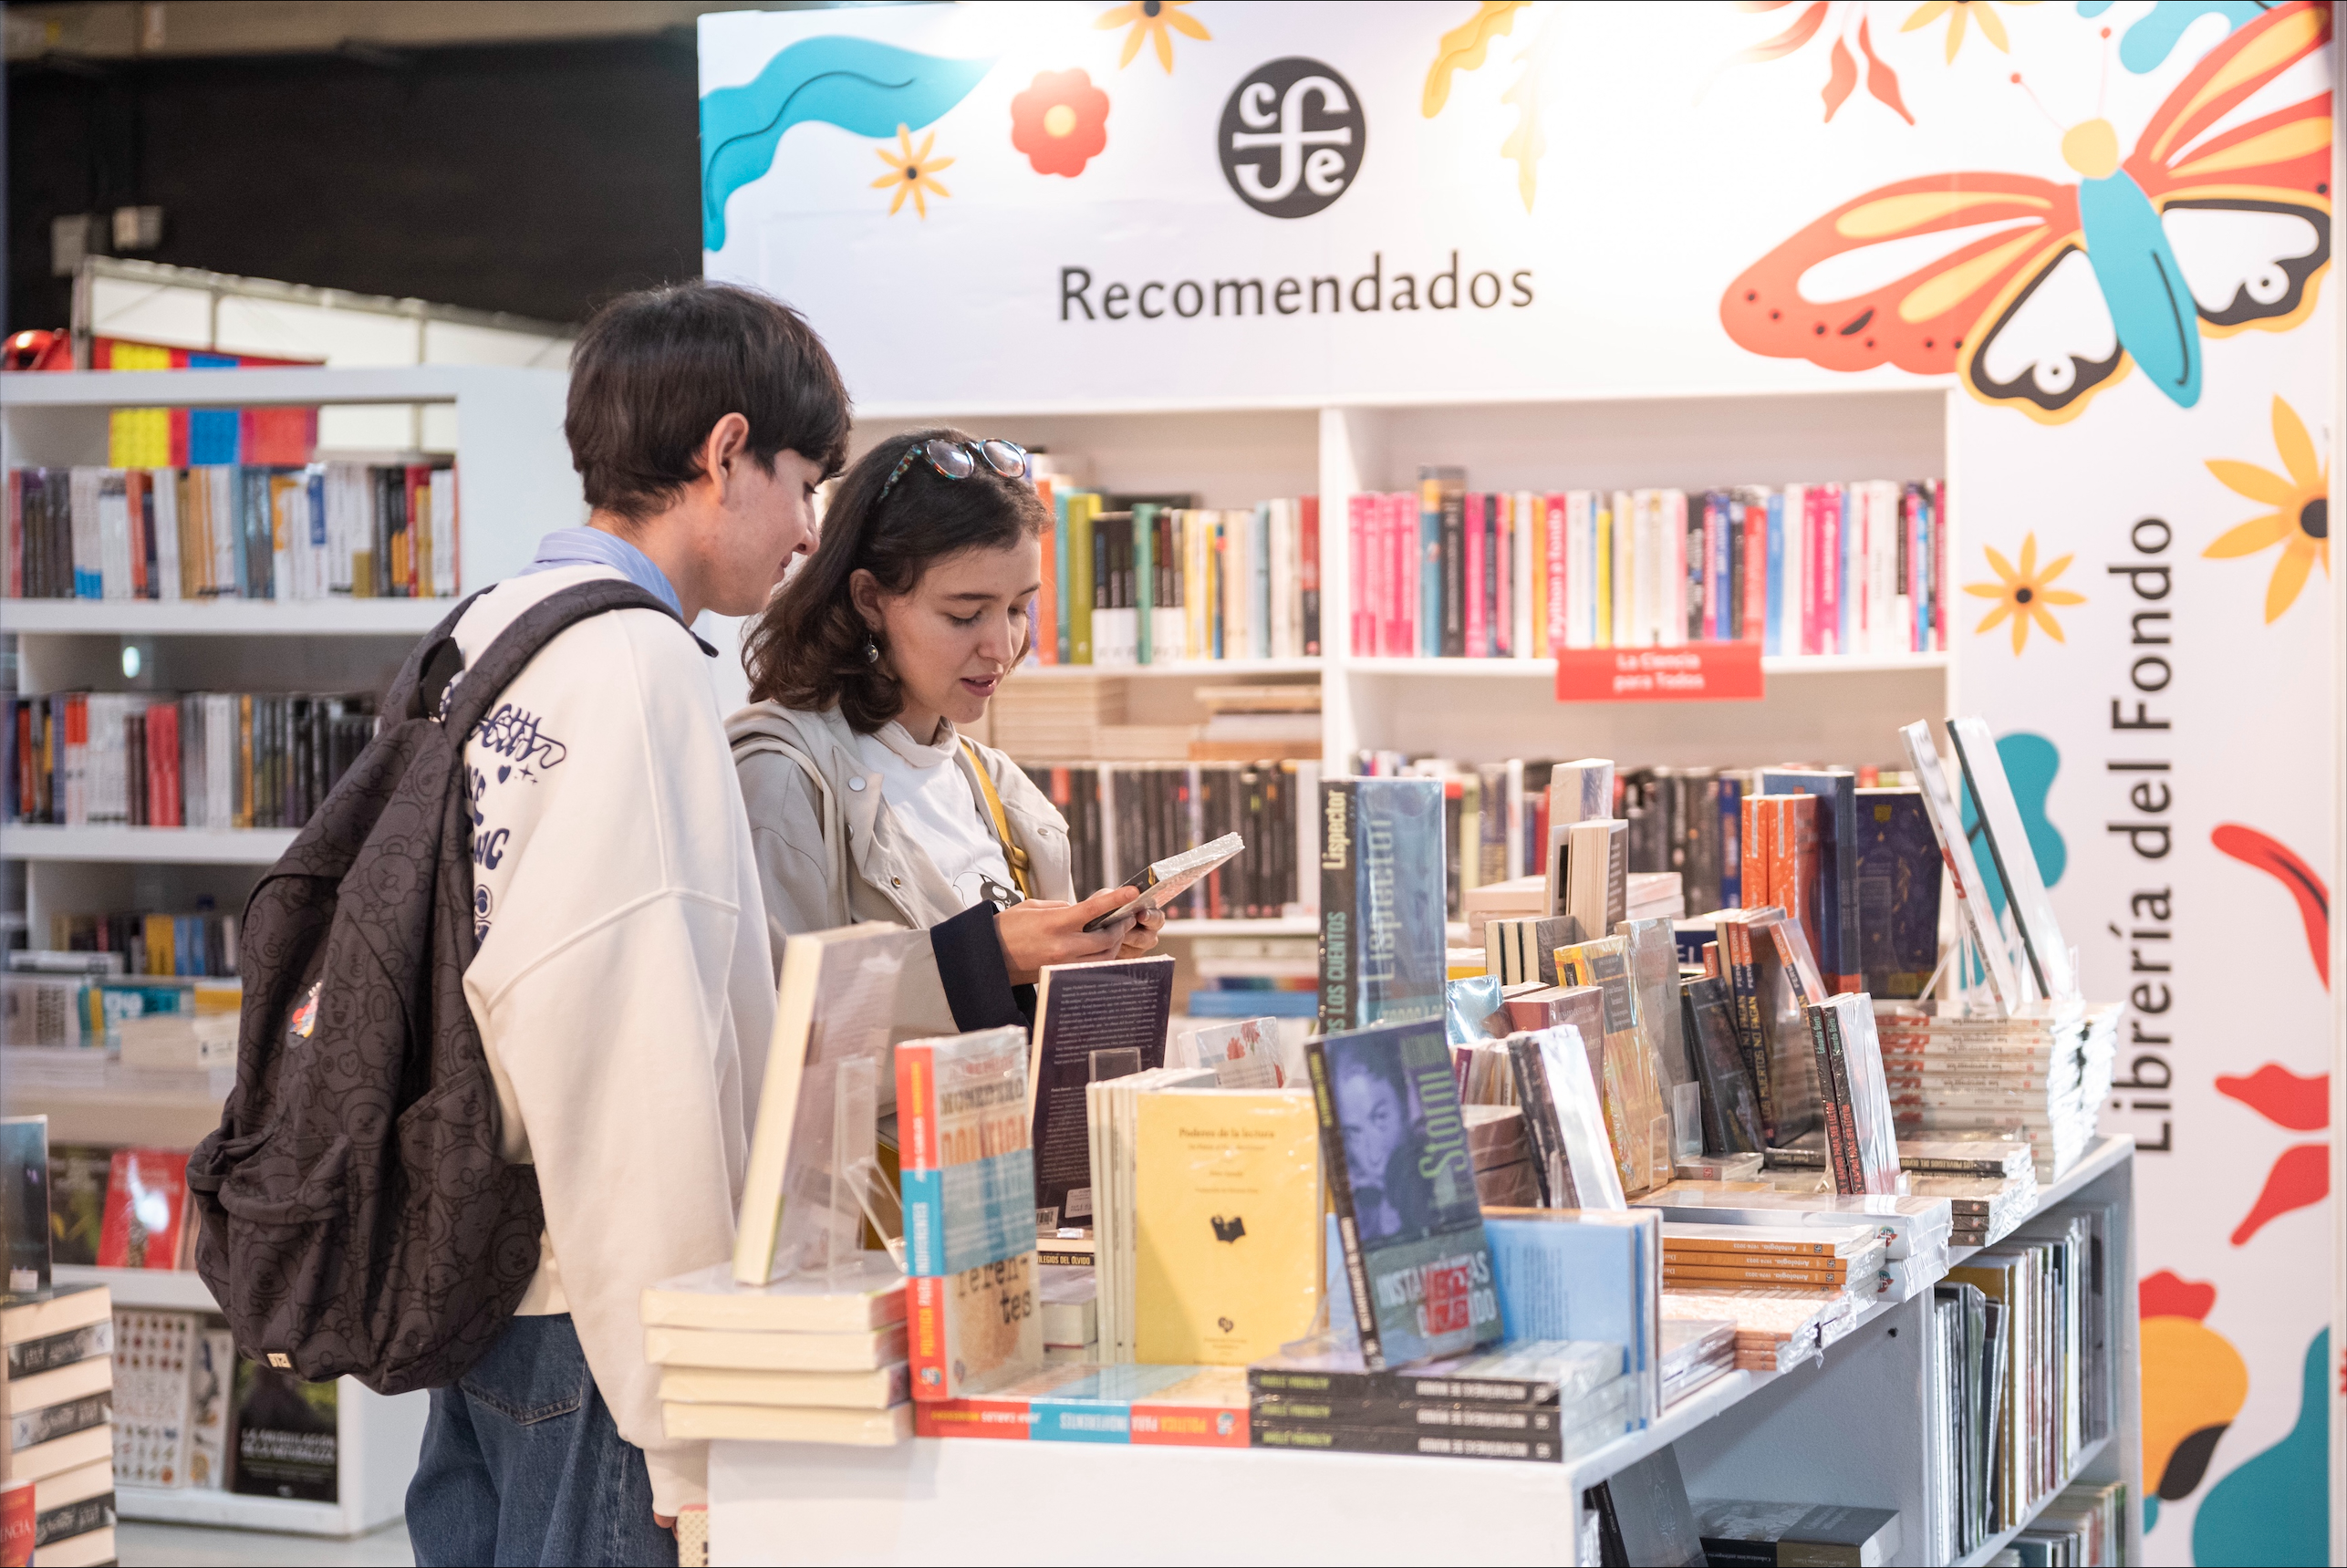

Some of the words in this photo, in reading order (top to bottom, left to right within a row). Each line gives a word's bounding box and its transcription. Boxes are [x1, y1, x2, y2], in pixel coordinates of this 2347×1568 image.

[1059, 248, 1535, 321] Recomendados
[2107, 515, 2173, 732] Fondo
[1614, 674, 1653, 692] para
[1656, 672, 1705, 690] Todos
[1615, 652, 1637, 670] La
[1640, 651, 1700, 670] Ciencia
[1323, 789, 1351, 870] Lispector
[2107, 763, 2173, 859] del
[1358, 819, 1402, 982] Lispector
[1326, 911, 1346, 981] CUENTOS
[1326, 984, 1346, 1014] LOS
[1748, 995, 1760, 1030] PAGAN
[2108, 886, 2173, 1153] Librería
[1179, 1127, 1215, 1137] Poderes
[1219, 1127, 1229, 1137] de
[1231, 1127, 1240, 1137] la
[1241, 1127, 1275, 1138] lectura
[1418, 1070, 1469, 1179] Storni
[1060, 1256, 1070, 1264] DEL
[1000, 1288, 1032, 1325] tes
